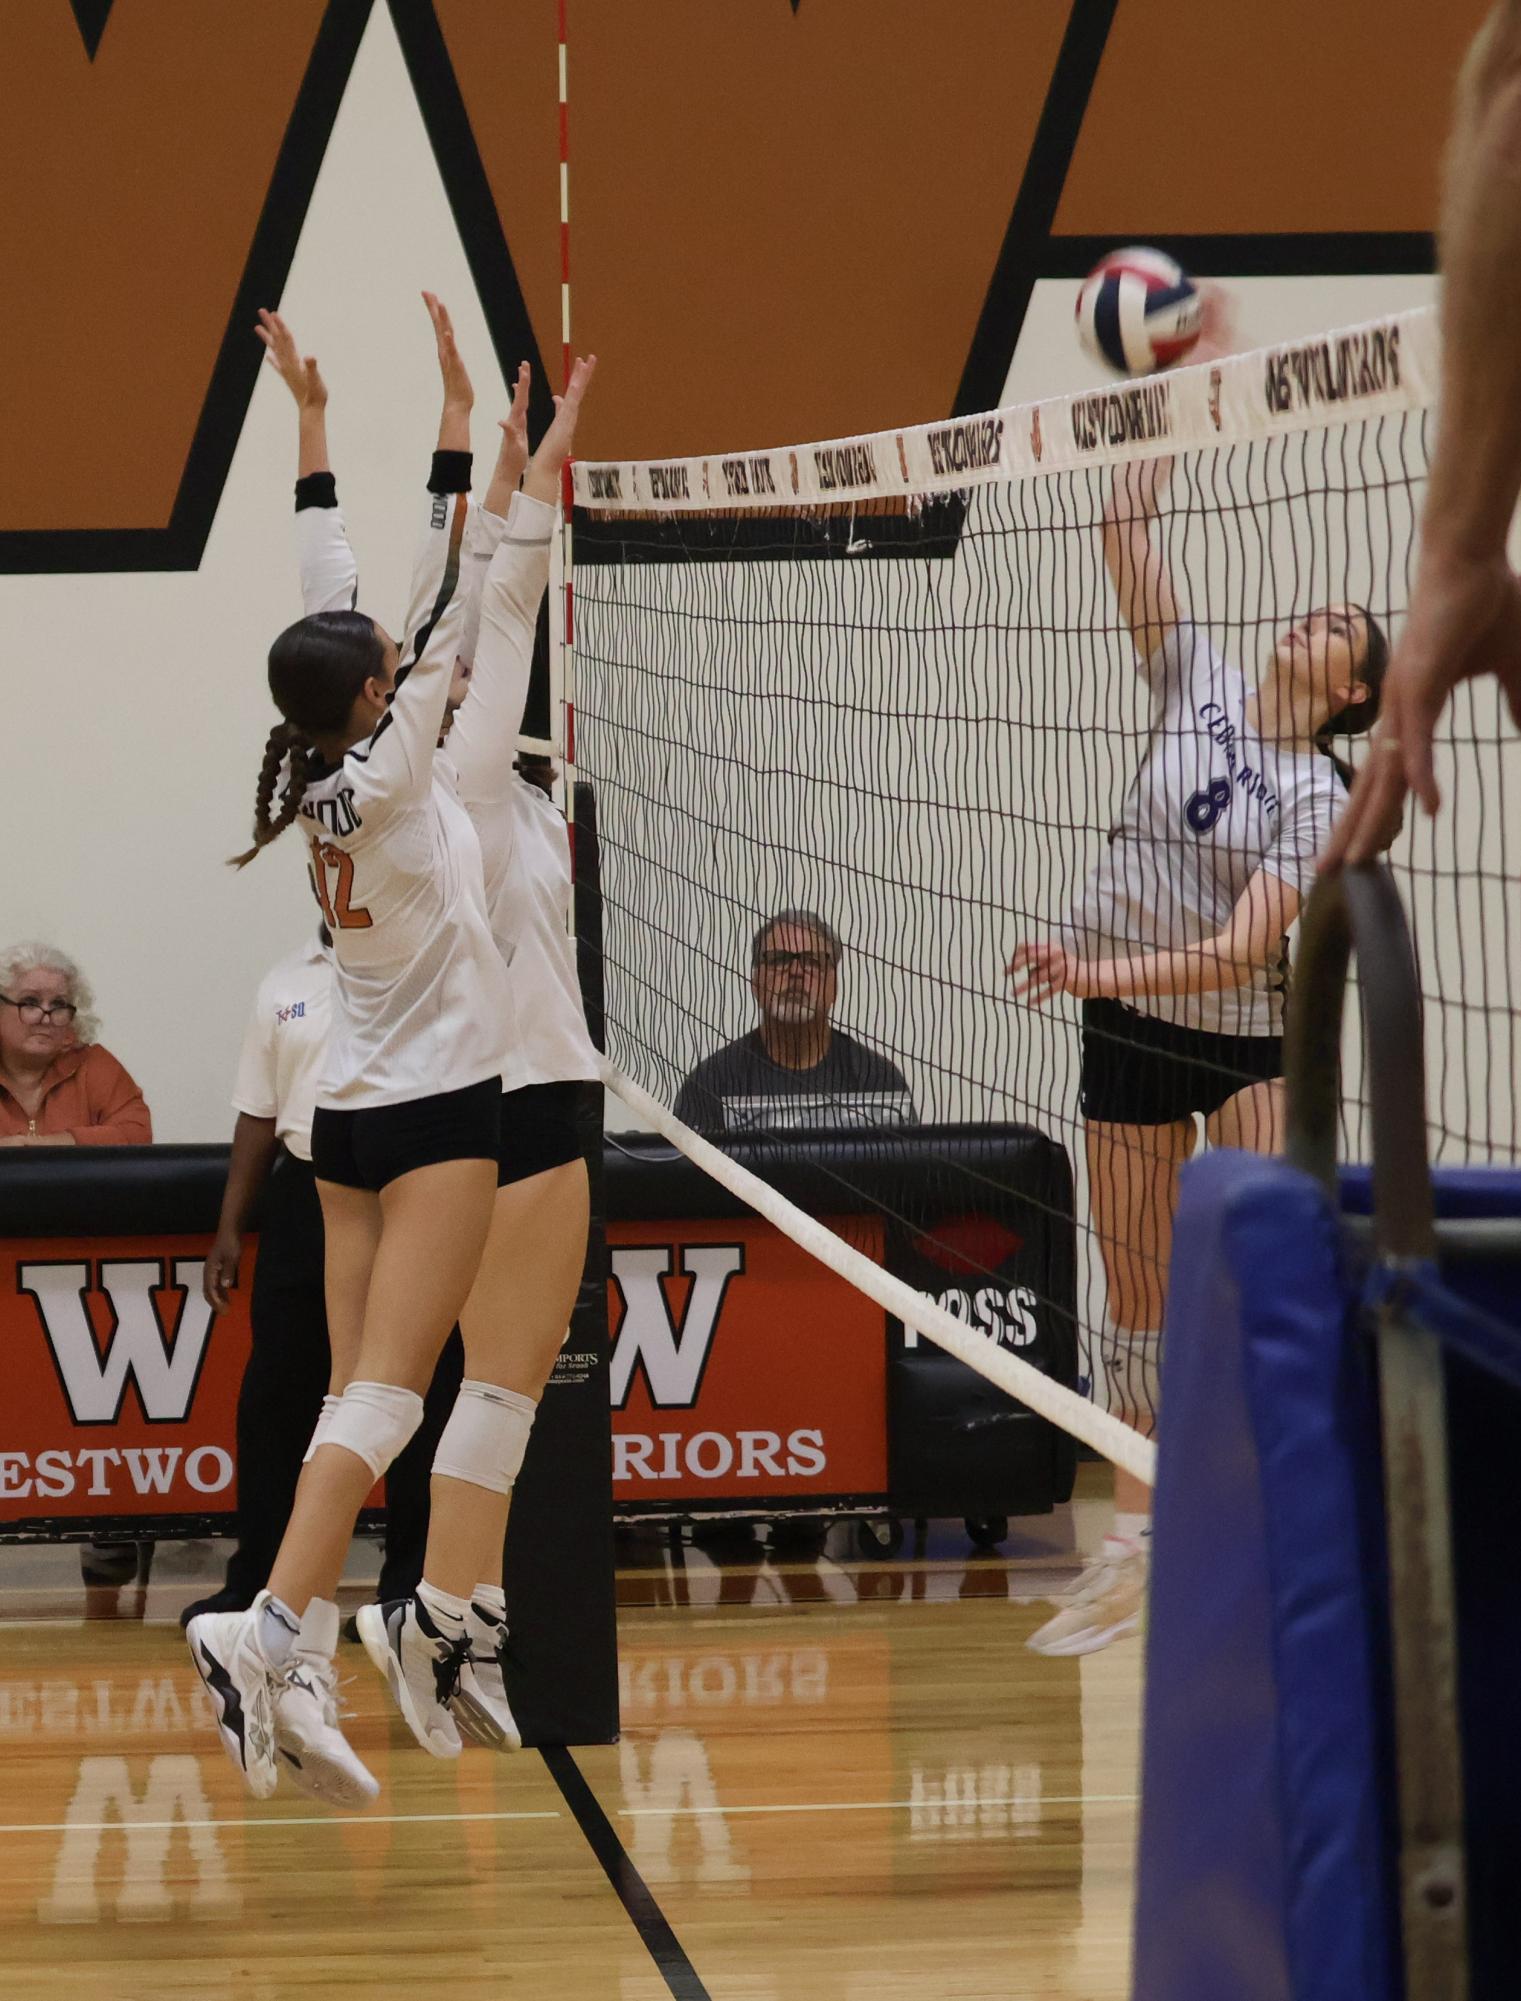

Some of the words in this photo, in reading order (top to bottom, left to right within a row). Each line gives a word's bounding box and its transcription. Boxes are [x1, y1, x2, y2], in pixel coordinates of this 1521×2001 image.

[1184, 775, 1231, 836] 8
[311, 835, 373, 928] 12
[16, 1257, 238, 1426] W
[0, 1446, 233, 1498] ESTWO
[611, 1429, 827, 1481] RIORS
